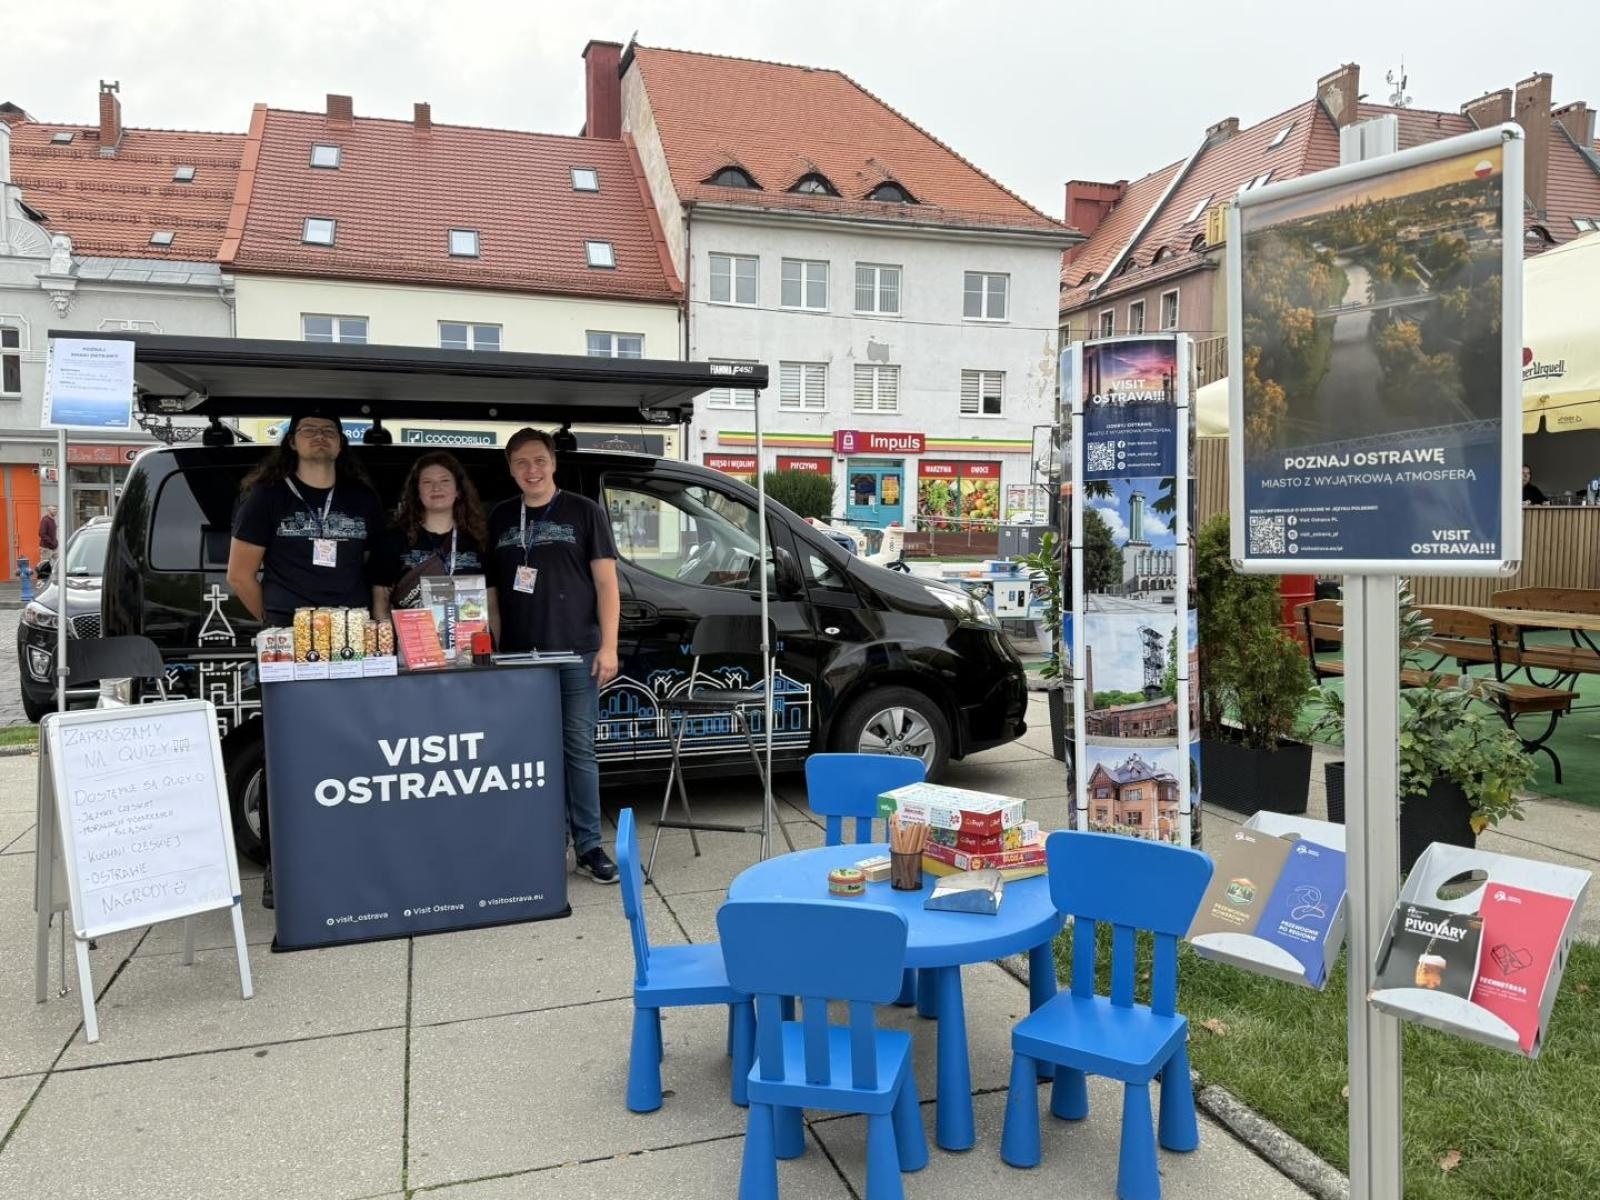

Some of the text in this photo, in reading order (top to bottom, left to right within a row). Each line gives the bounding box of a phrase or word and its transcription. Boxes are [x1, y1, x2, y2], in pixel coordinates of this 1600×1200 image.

[1112, 379, 1146, 390] VISIT
[1092, 391, 1166, 405] OSTRAVA!!!
[425, 434, 491, 446] COCCODRILLO
[870, 434, 920, 451] Impuls
[41, 447, 53, 457] 10
[1284, 448, 1446, 470] POZNAJ OSTRAWĘ
[1261, 469, 1477, 489] MIASTO Z WYJĄTKOWĄ ATMOSFERĄ
[1432, 529, 1471, 541] VISIT
[1411, 542, 1496, 555] OSTRAVA!!!
[64, 723, 162, 747] ZAPRASZAMY
[377, 731, 484, 766] VISIT
[85, 750, 107, 769] NA
[314, 760, 545, 807] OSTRAVA!!!
[487, 893, 544, 906] visitostrava.eu
[412, 902, 465, 916] Visit Ostrava
[336, 910, 389, 924] visit_ostrava
[1404, 917, 1468, 941] PIVOVARY
